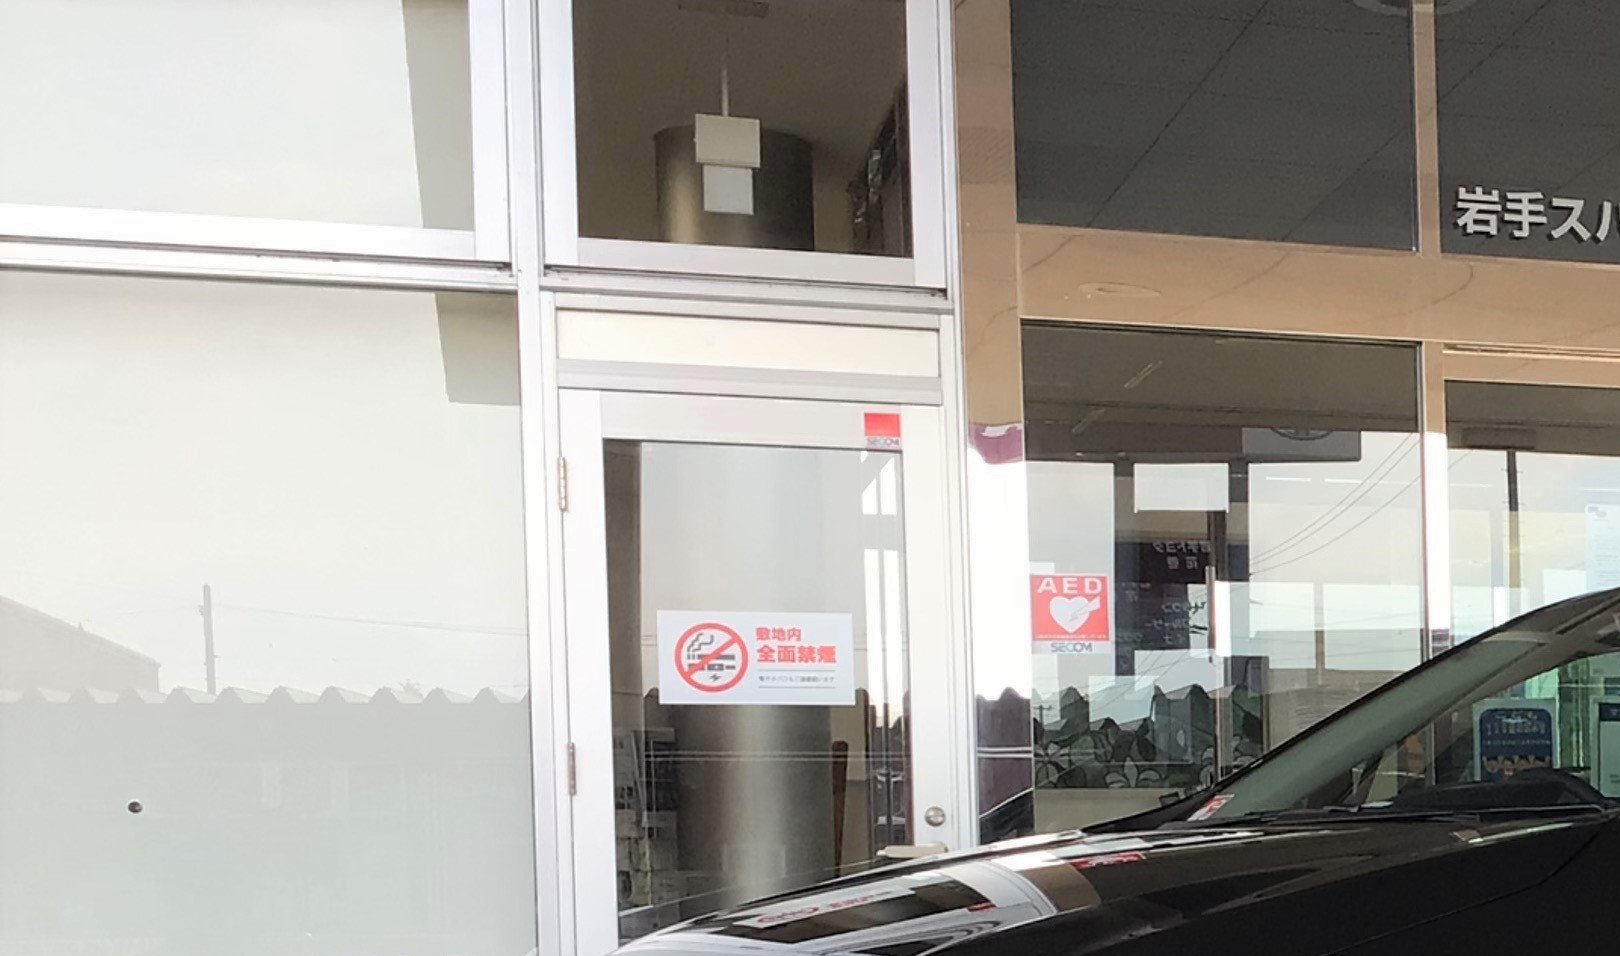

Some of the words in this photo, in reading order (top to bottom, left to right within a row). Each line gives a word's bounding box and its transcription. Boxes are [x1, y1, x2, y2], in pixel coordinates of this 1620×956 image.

[1036, 577, 1102, 594] AED
[755, 627, 802, 642] 敷地内
[756, 644, 837, 664] 全面禁煙
[1050, 642, 1093, 653] SECOM
